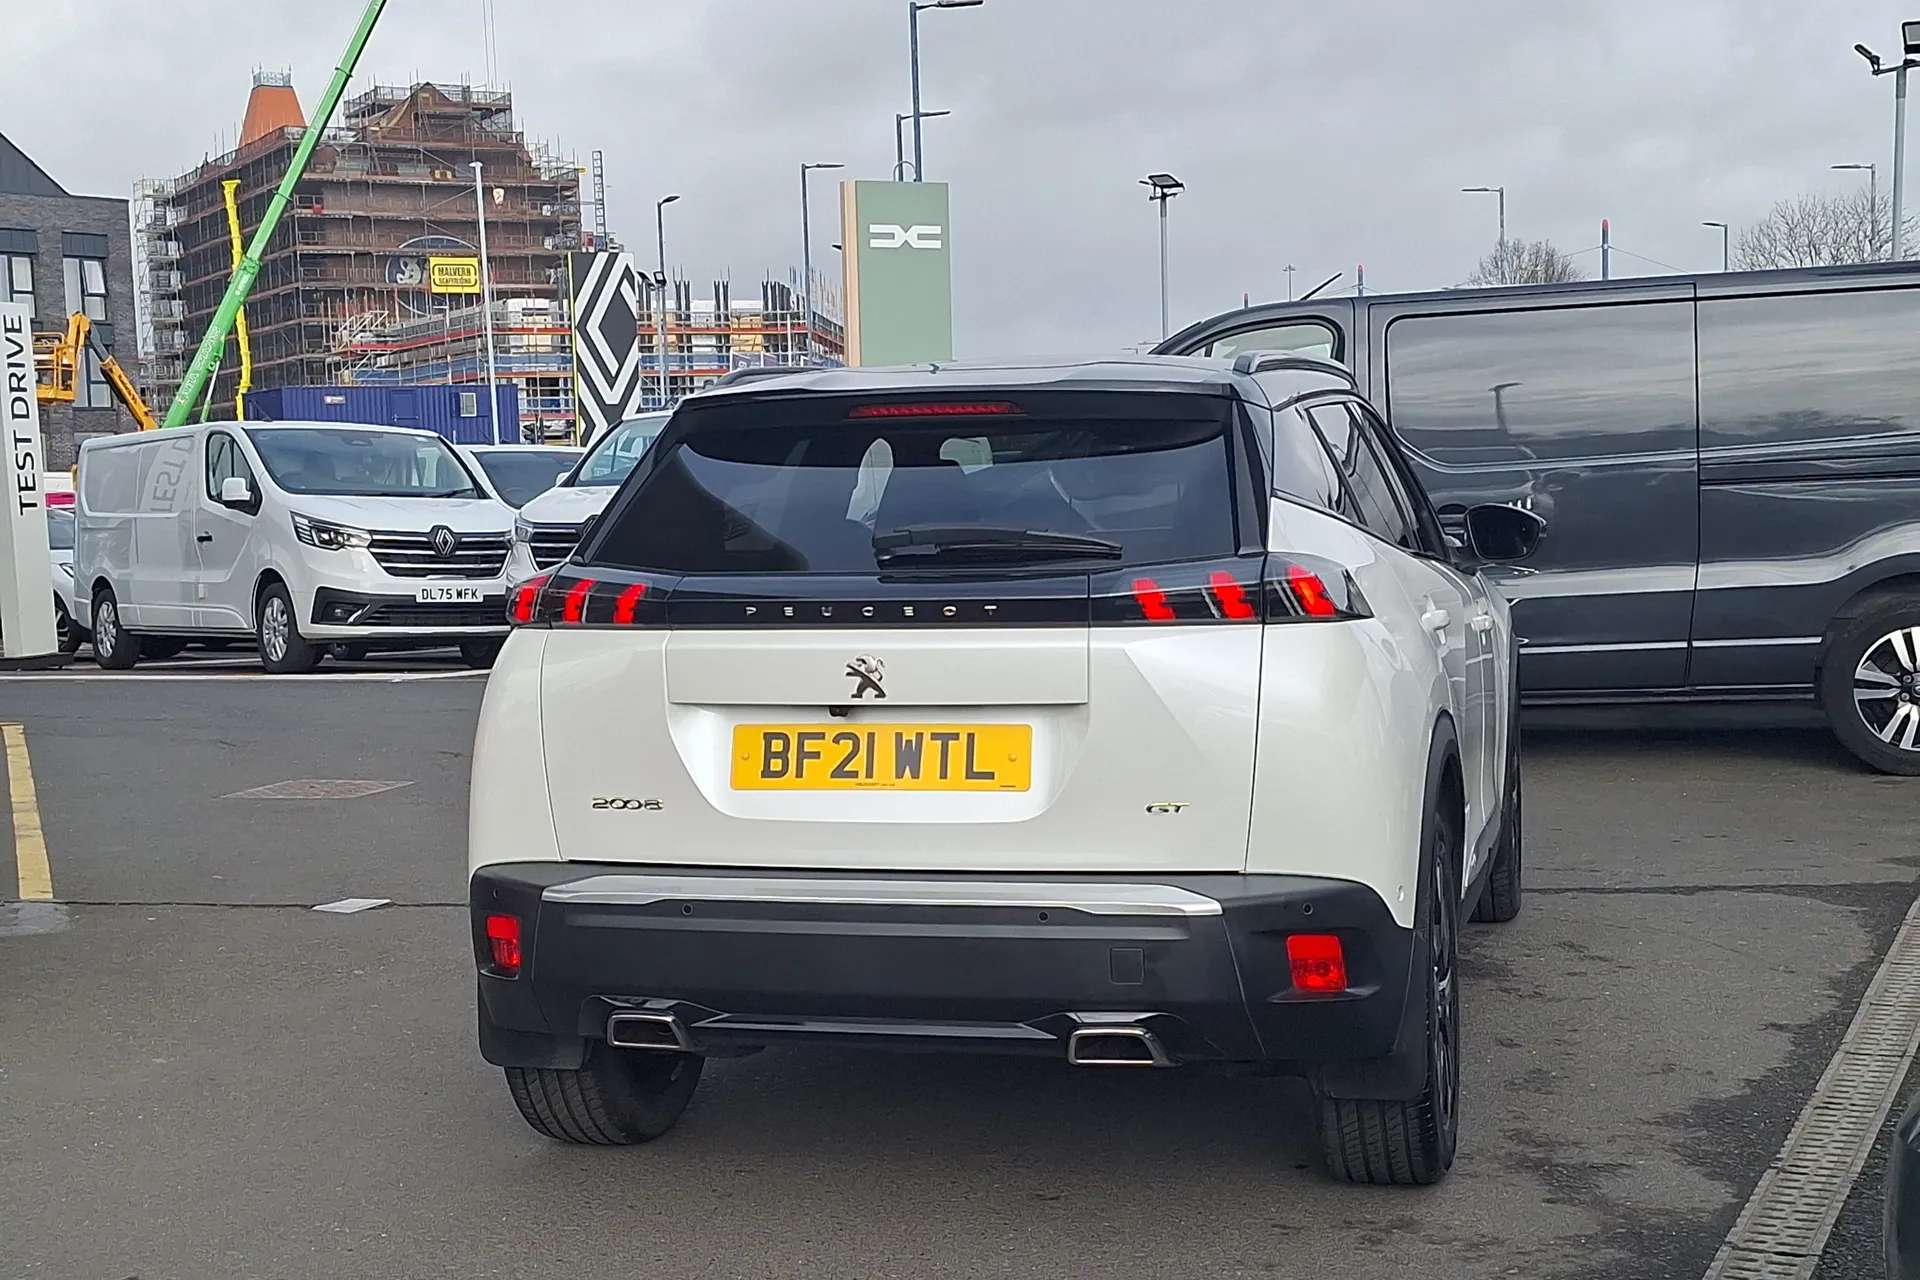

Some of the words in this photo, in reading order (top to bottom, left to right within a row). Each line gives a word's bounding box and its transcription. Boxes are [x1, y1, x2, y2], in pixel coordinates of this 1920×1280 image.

[438, 267, 471, 276] MALVERN
[3, 314, 30, 420] DRIVE
[13, 429, 38, 516] TEST
[421, 588, 453, 600] DL75
[456, 588, 478, 600] WFK
[745, 605, 998, 617] PEUGEOT
[761, 731, 875, 779] BF21
[894, 732, 995, 780] WTL
[592, 798, 664, 810] 2008
[1145, 802, 1190, 814] GT
